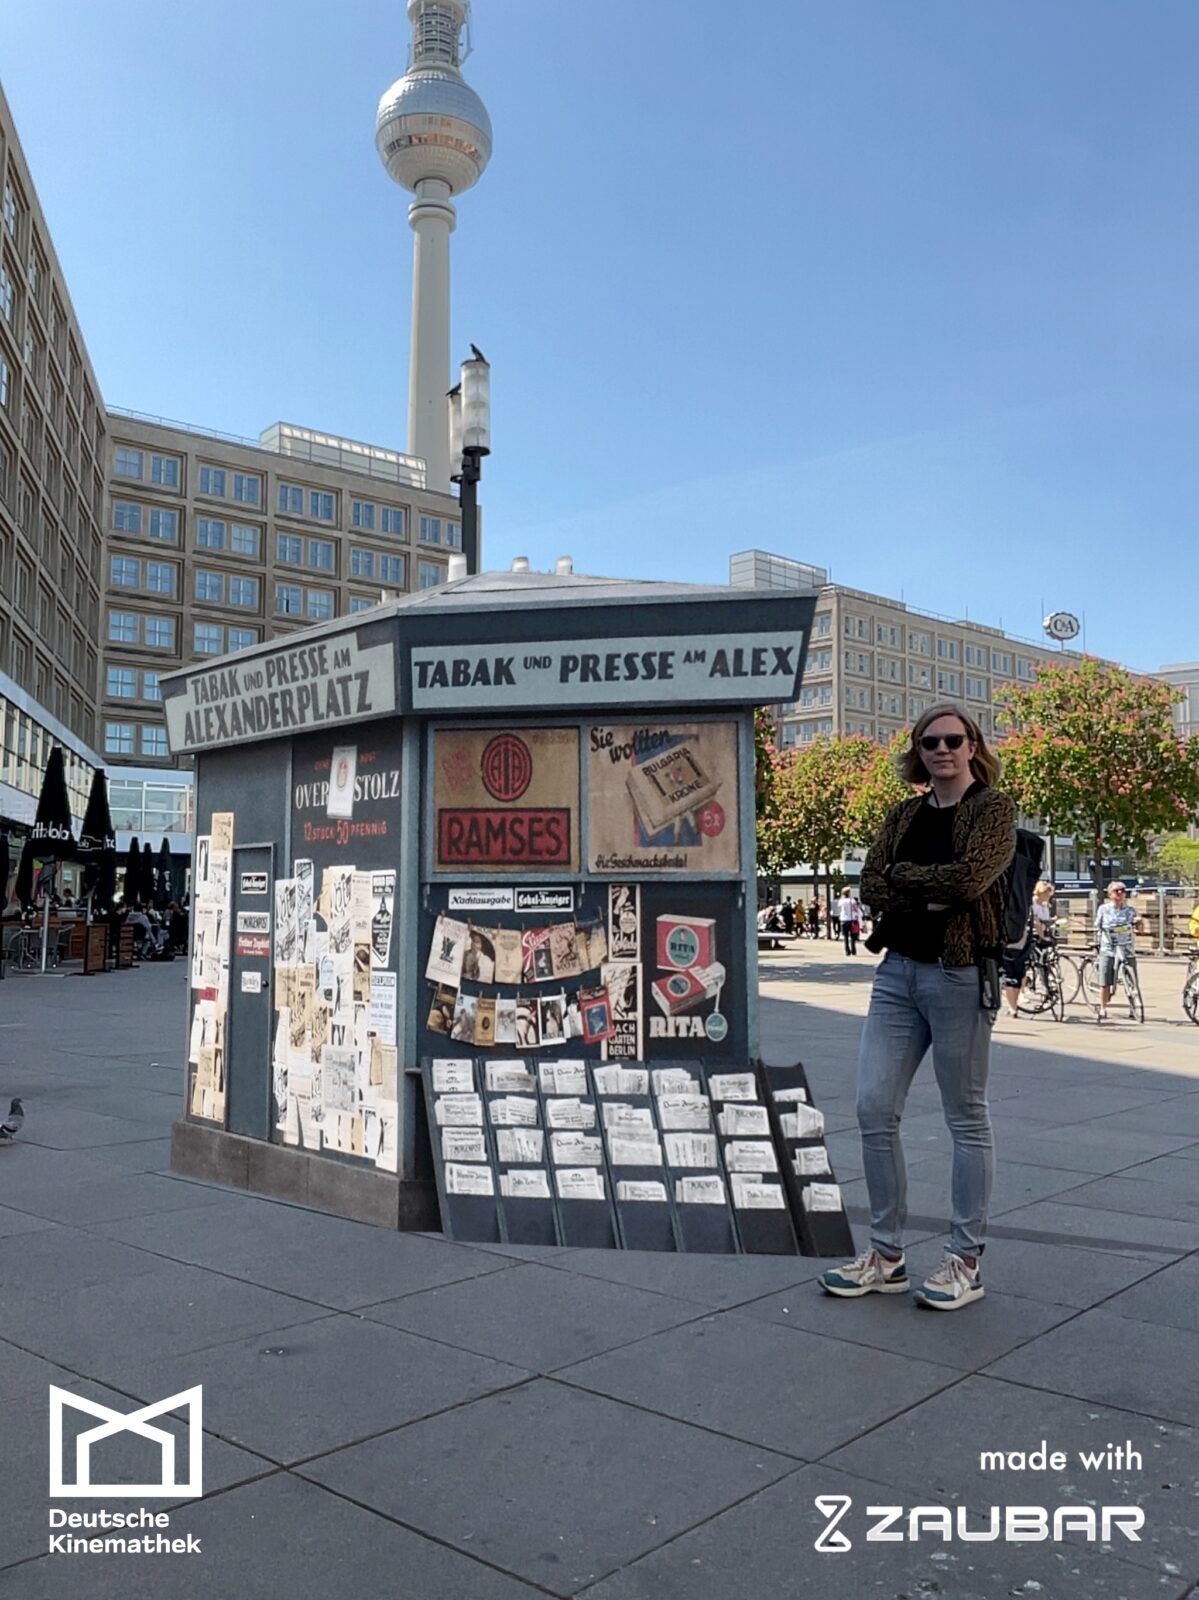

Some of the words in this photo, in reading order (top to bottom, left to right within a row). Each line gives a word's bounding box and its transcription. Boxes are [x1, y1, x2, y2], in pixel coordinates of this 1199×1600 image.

[1053, 618, 1075, 633] C&A
[191, 669, 240, 705] TABAK
[243, 670, 264, 691] UND
[265, 644, 330, 689] PRESSE
[333, 647, 352, 671] AM
[414, 656, 516, 689] TABAK
[523, 656, 552, 671] UND
[559, 650, 676, 684] PRESSE
[682, 650, 706, 664] AM
[709, 646, 794, 678] ALEX
[184, 670, 372, 745] ALEXANDERPLATZ
[590, 726, 614, 753] Sie
[608, 729, 671, 765] wollten
[641, 746, 691, 777] BULGARIA
[295, 781, 329, 809] OVER
[353, 770, 400, 802] STOLZ
[668, 779, 704, 804] KRONE
[447, 814, 562, 857] RAMSES
[451, 896, 512, 906] Nachtausgabe
[649, 1016, 706, 1038] RITA
[609, 1045, 636, 1056] BERLIN
